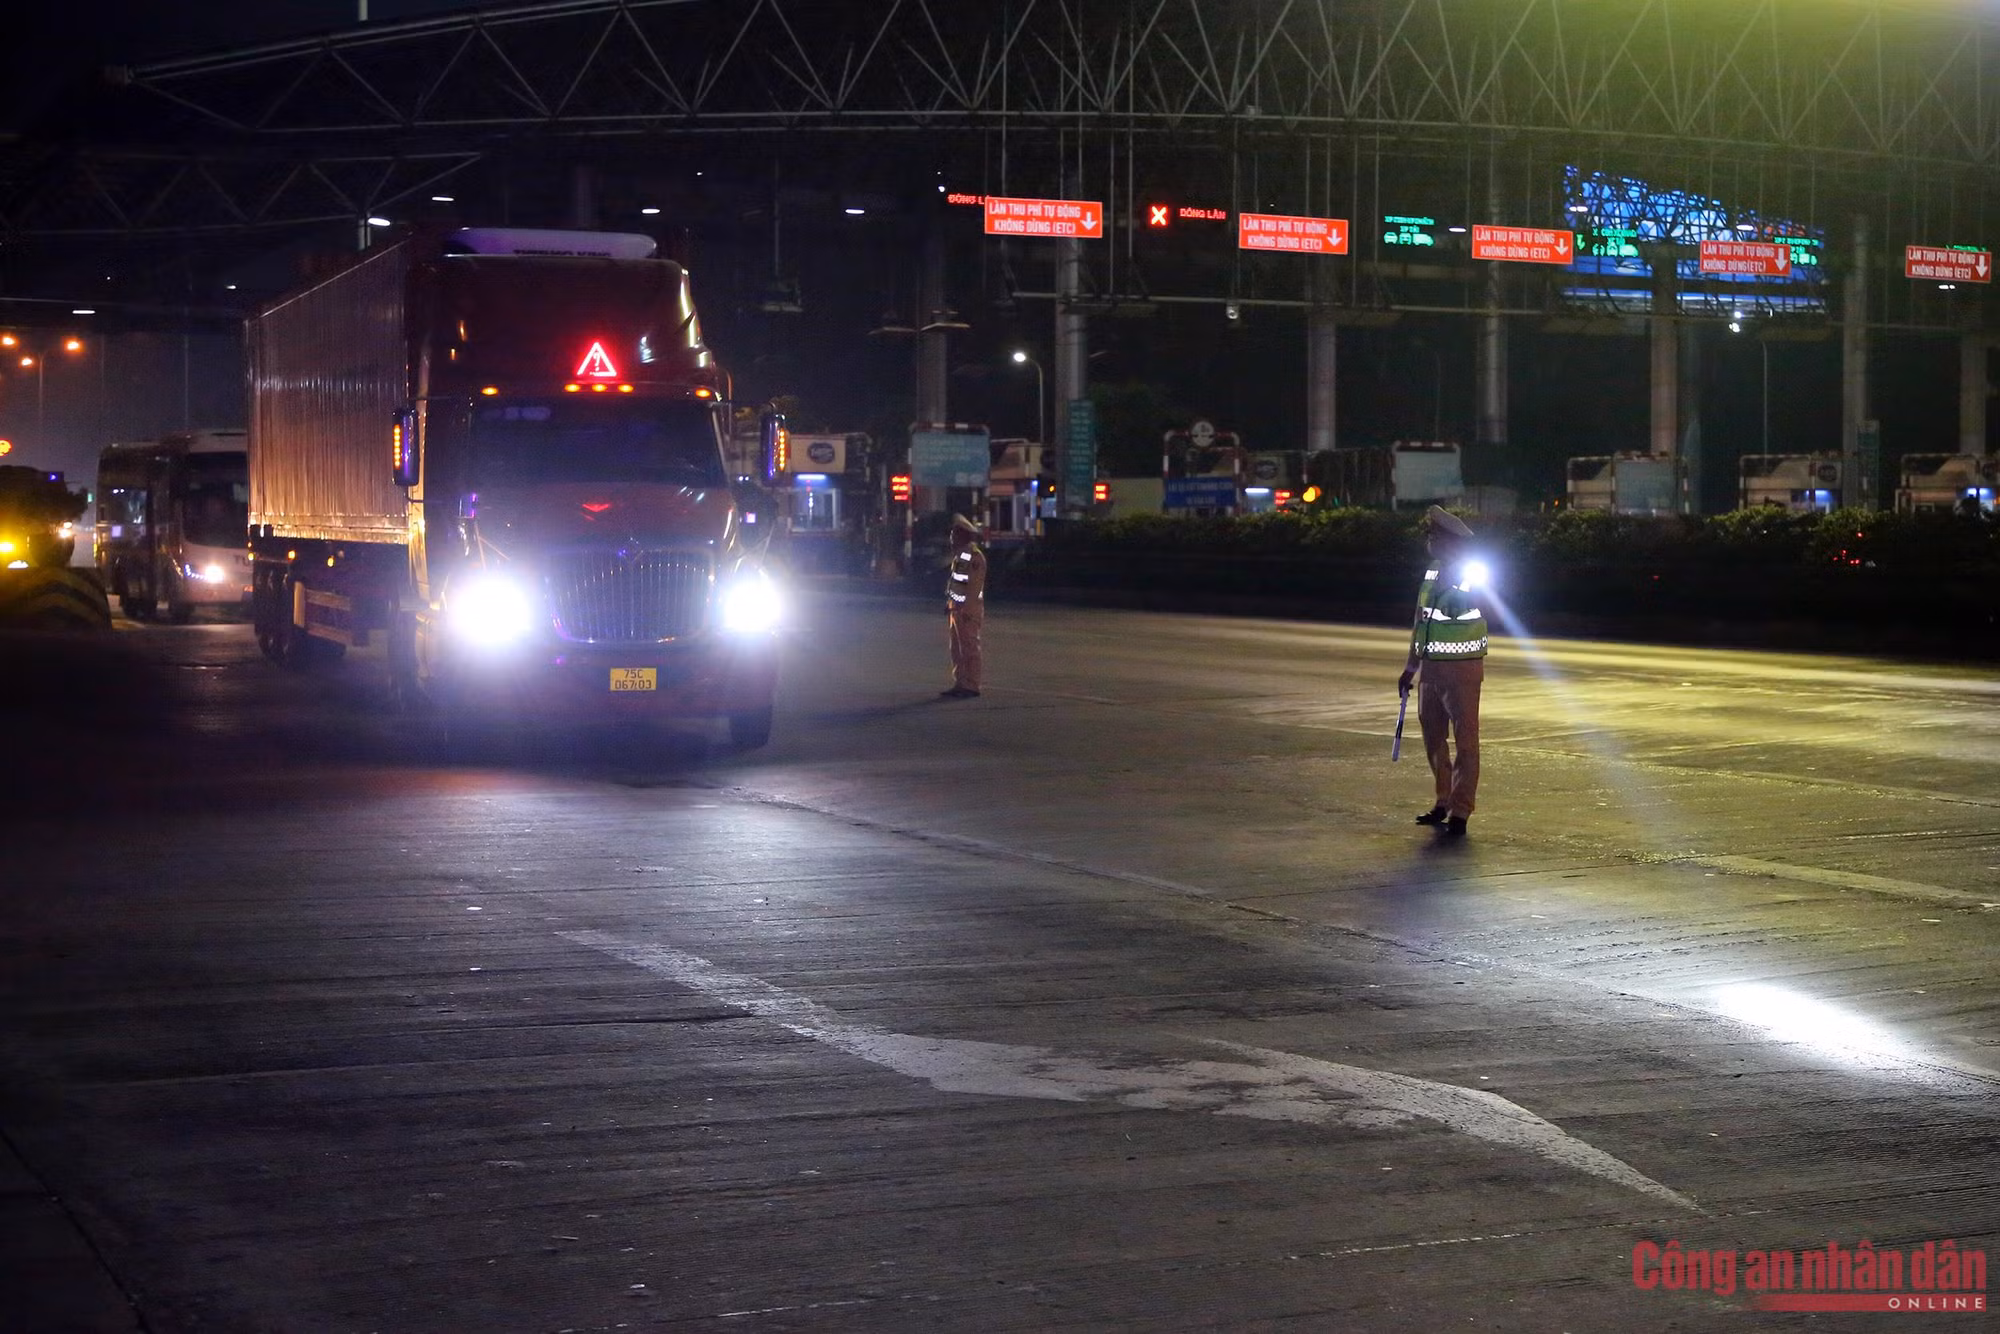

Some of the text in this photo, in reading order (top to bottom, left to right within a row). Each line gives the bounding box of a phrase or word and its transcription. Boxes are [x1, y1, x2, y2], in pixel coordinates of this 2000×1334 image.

[989, 200, 1006, 214] LÀN
[1009, 203, 1025, 216] THU
[1028, 202, 1042, 216] PHÍ
[1044, 204, 1055, 218] TỰ
[1057, 204, 1081, 218] ĐỘNG
[994, 218, 1076, 234] KHÔNG DỪNG (ETC)
[1243, 217, 1259, 230] LÀN
[1261, 220, 1277, 232] THU
[1278, 219, 1292, 232] PHÍ
[1306, 221, 1328, 234] ĐỘNG
[1248, 234, 1322, 250] KHÔNG DỪNG (ETC)
[1476, 228, 1555, 244] LÀN THU PHÍ TỰ ĐỘNG
[1480, 244, 1550, 259] KHÔNG DỪNG (ETC)
[1703, 242, 1716, 255] LÀN
[1718, 244, 1731, 255] THU
[1733, 244, 1745, 256] PHÍ
[1908, 247, 1921, 260] LÀN
[1923, 251, 1935, 261] THU
[1703, 259, 1727, 271] KHÔNG
[1912, 264, 1934, 276] KHÔNG
[1955, 267, 1971, 279] (ETC)
[624, 670, 643, 678] 75C
